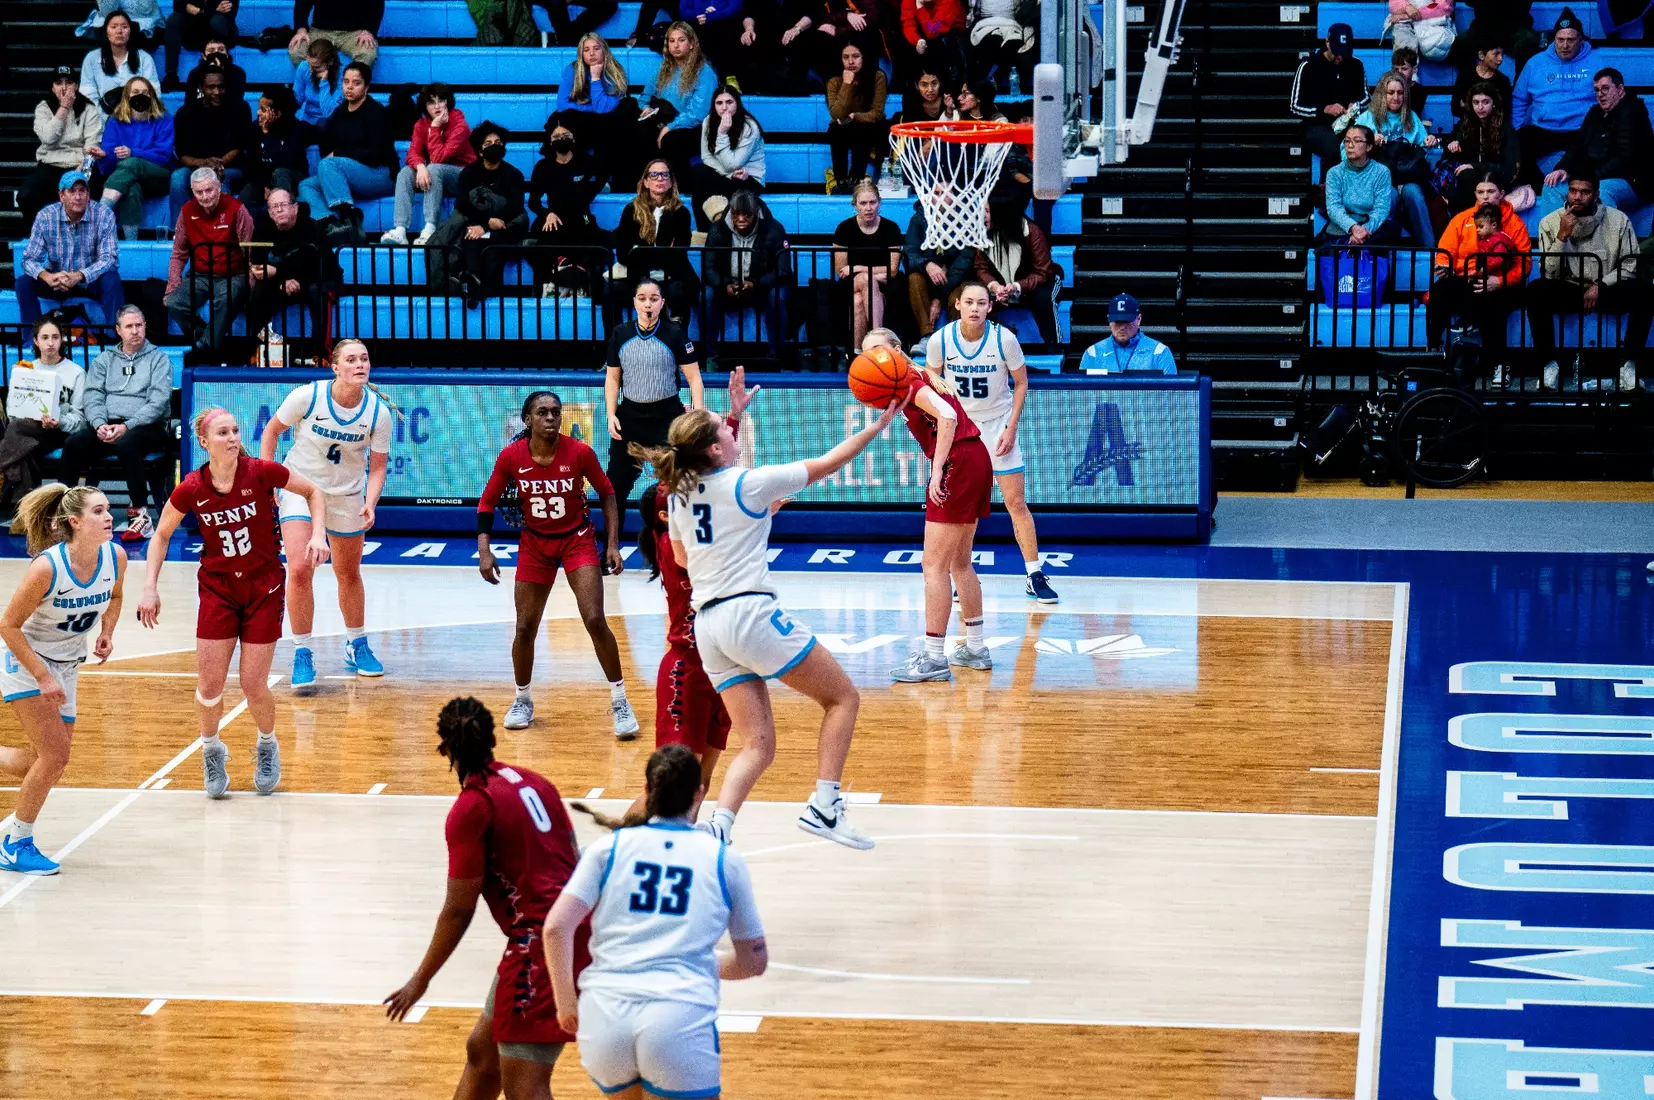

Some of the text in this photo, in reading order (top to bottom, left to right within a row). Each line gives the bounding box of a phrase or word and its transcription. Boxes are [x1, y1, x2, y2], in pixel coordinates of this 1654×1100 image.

[1117, 300, 1126, 312] C
[954, 375, 989, 399] 35
[311, 423, 366, 442] COLUMBIA
[326, 443, 342, 464] 4
[518, 477, 575, 495] PENN
[200, 501, 257, 527] PENN
[529, 496, 567, 520] 23
[692, 503, 714, 545] 3
[218, 526, 252, 557] 32
[55, 611, 99, 633] 10
[770, 608, 795, 636] C
[518, 785, 552, 833] 0
[628, 861, 694, 916] 33
